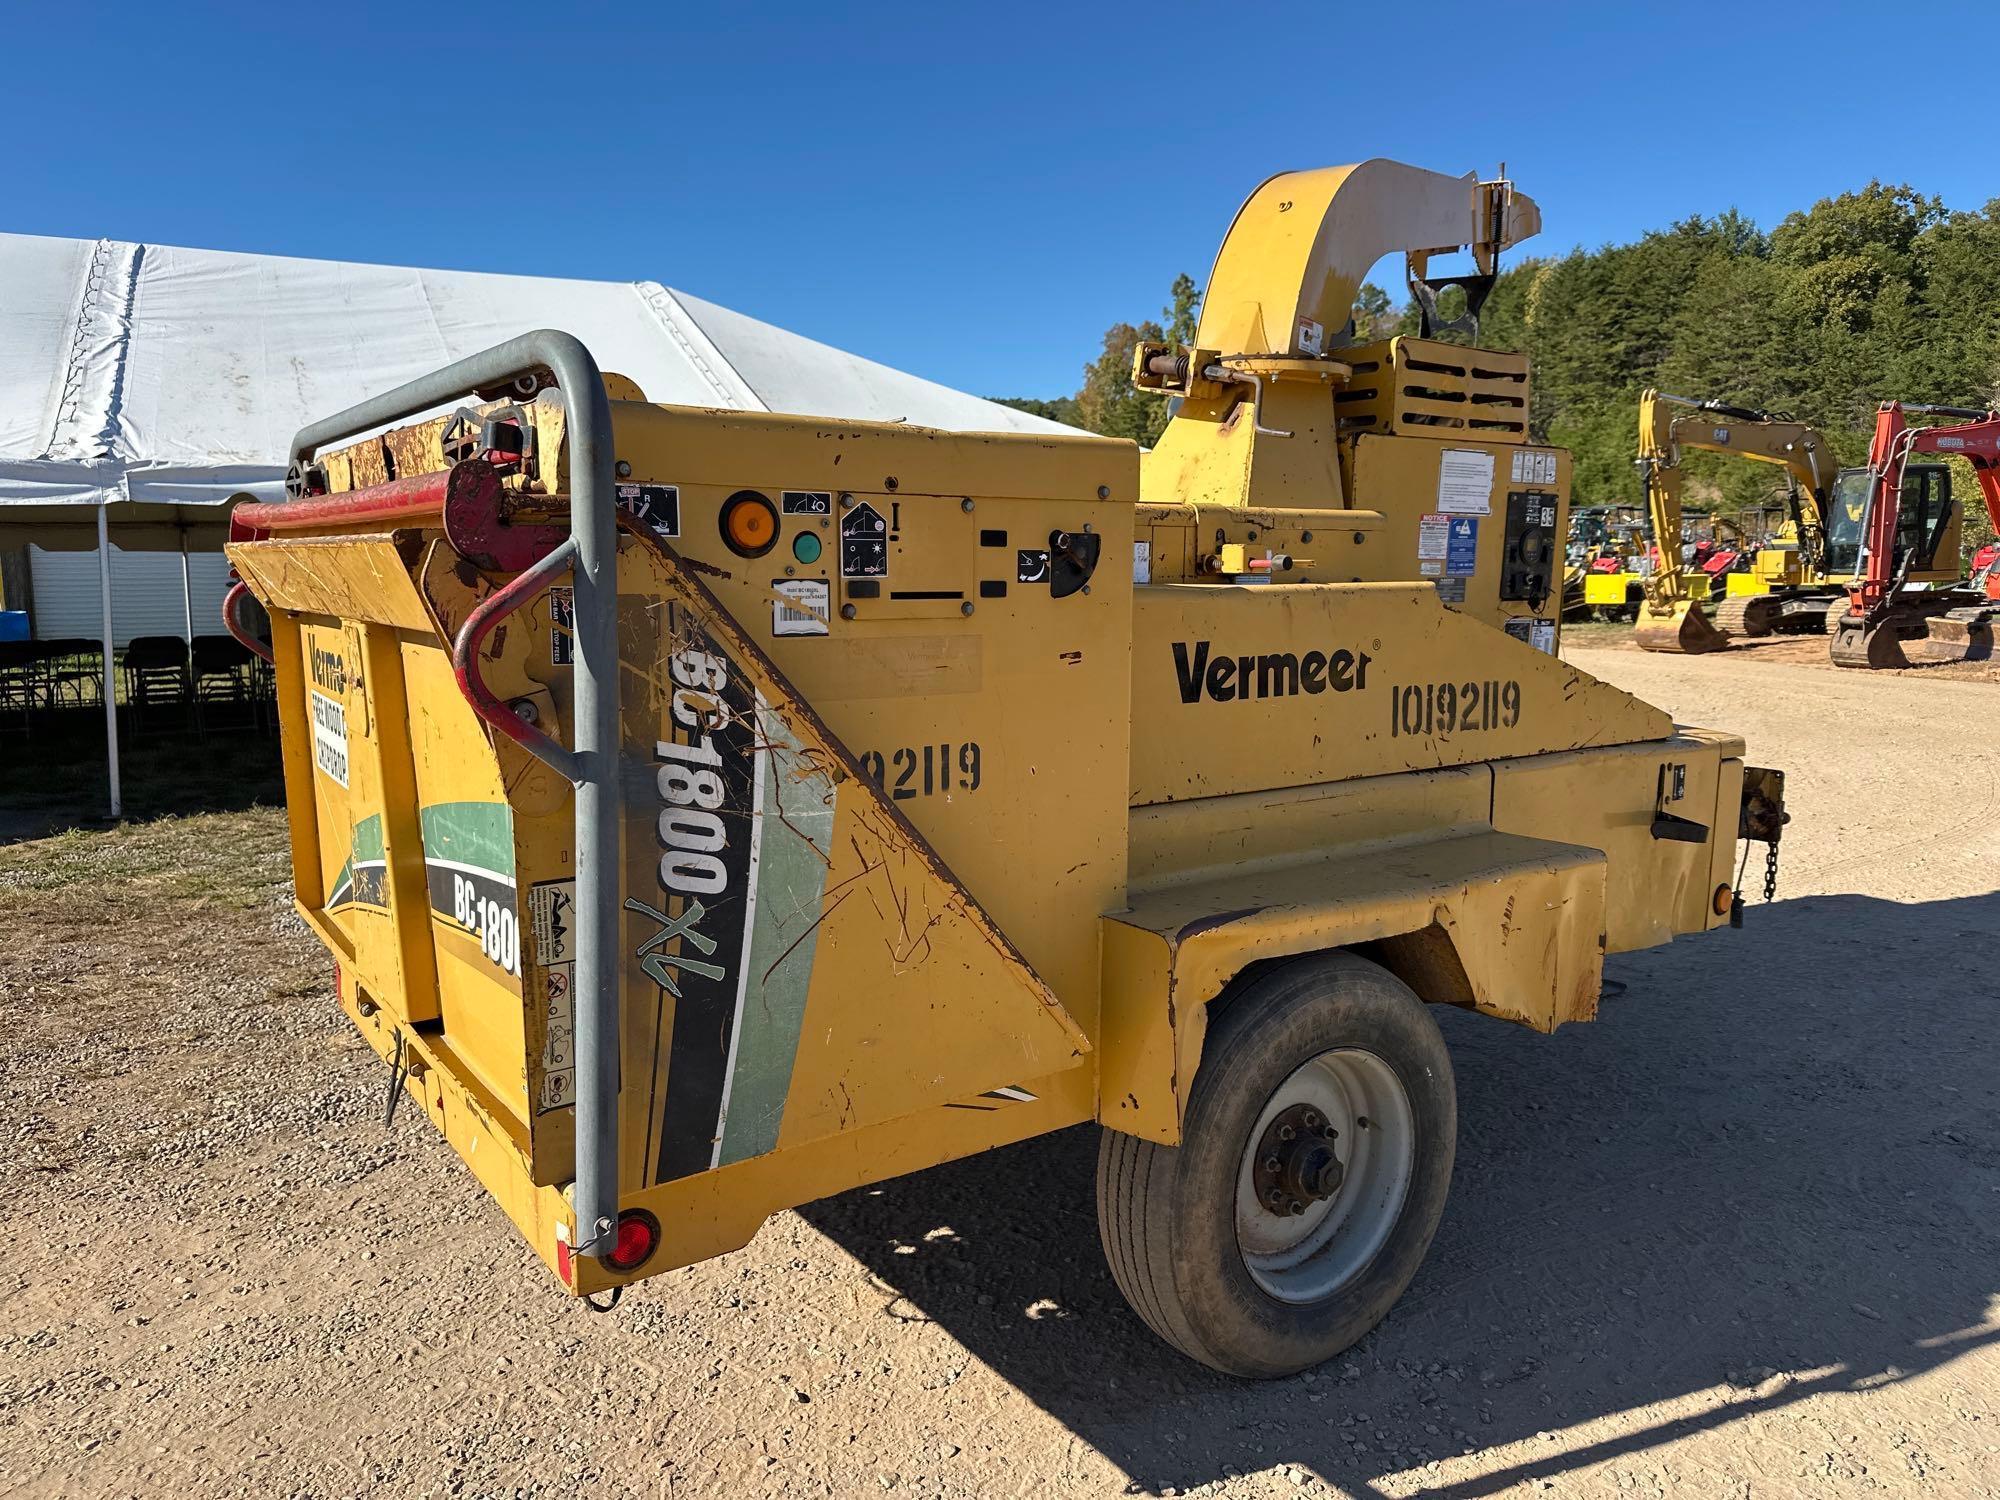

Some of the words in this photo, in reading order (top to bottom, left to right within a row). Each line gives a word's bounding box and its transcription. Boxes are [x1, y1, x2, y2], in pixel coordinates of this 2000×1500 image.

[644, 495, 651, 503] R
[1542, 507, 1554, 526] 35
[308, 633, 345, 695] Verme
[1171, 641, 1372, 704] Vermeer
[324, 700, 341, 738] WOOD
[1391, 681, 1521, 738] 10192119
[317, 736, 349, 786] CHIPDROP.
